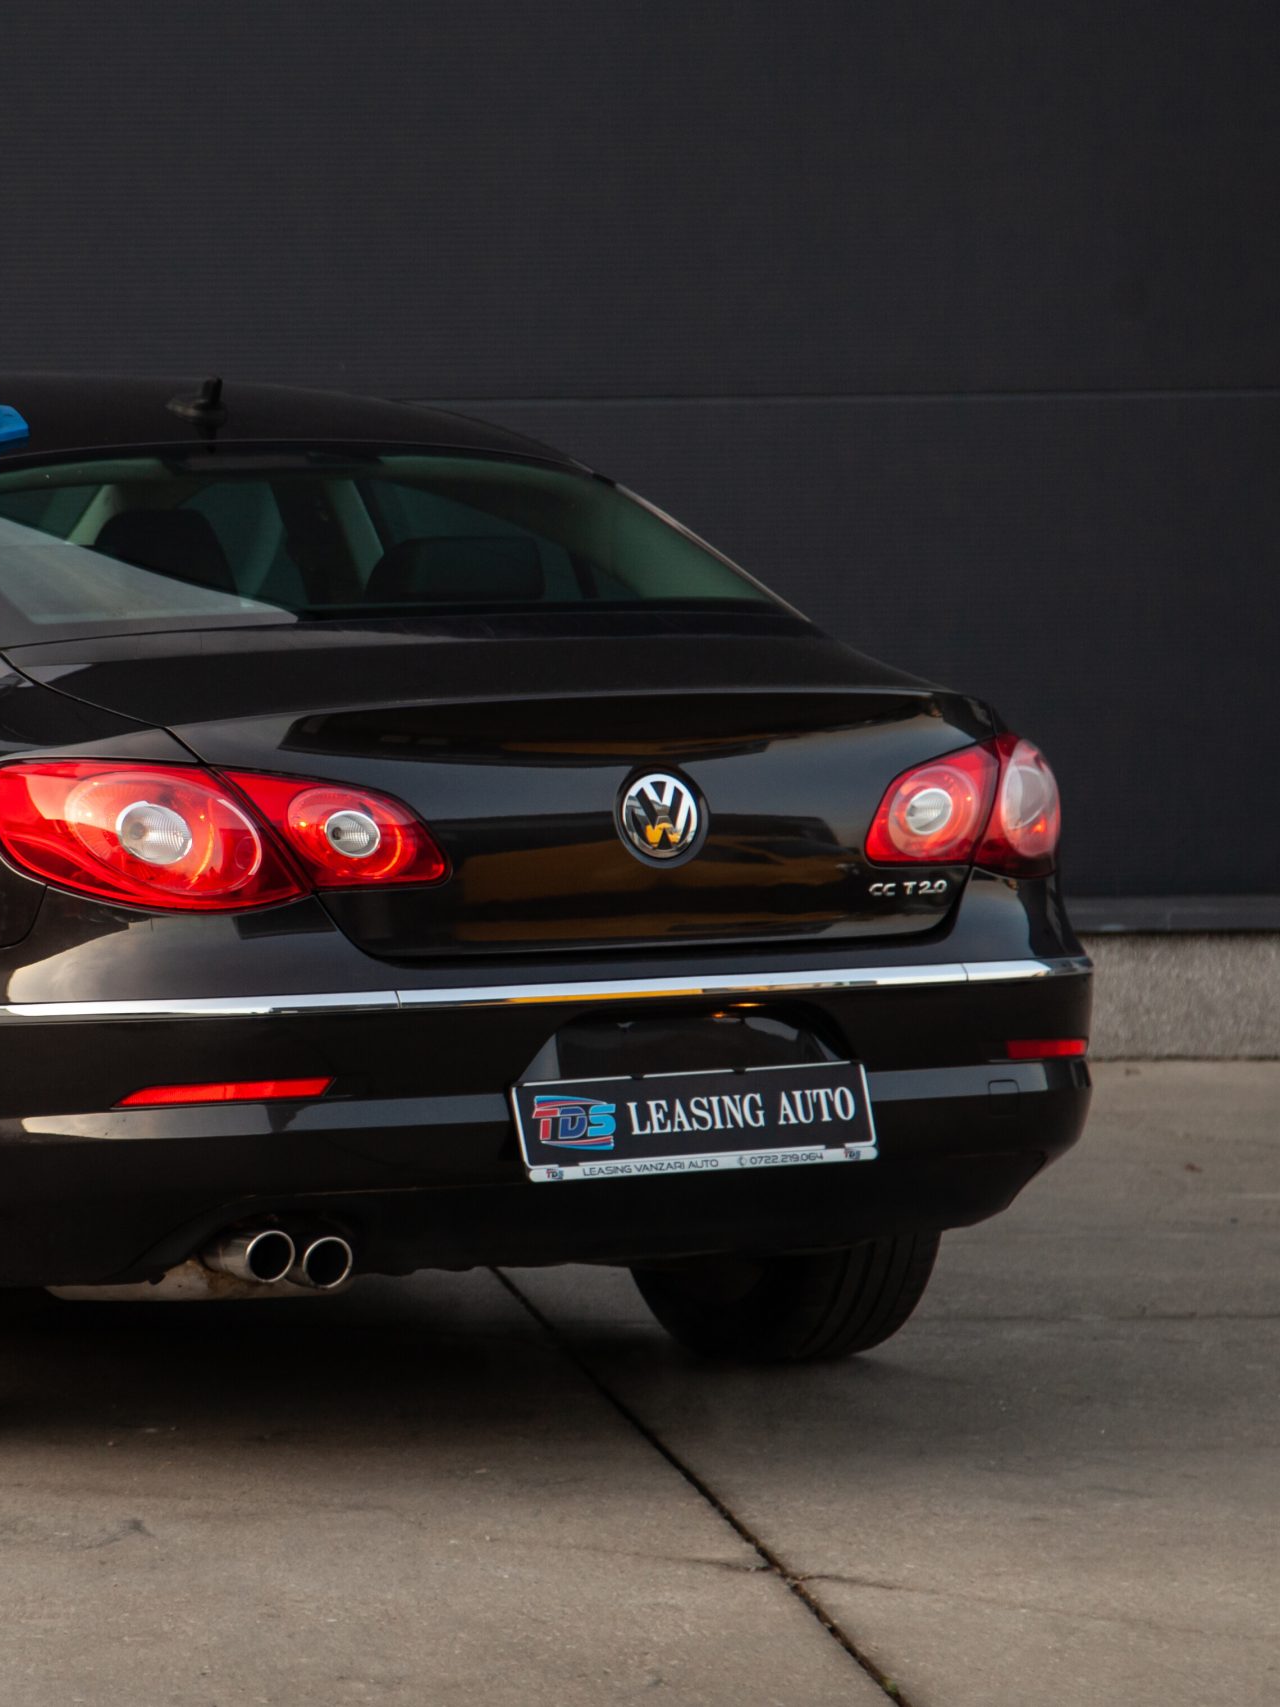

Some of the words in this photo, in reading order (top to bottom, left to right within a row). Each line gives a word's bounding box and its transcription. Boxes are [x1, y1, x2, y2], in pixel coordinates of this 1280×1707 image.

[868, 882, 897, 896] CC
[532, 1103, 617, 1141] TDS
[626, 1093, 765, 1136] LEASING
[777, 1086, 856, 1126] AUTO
[582, 1163, 632, 1177] LEASING
[634, 1161, 685, 1173] VANZARI
[687, 1158, 719, 1171] AUTO
